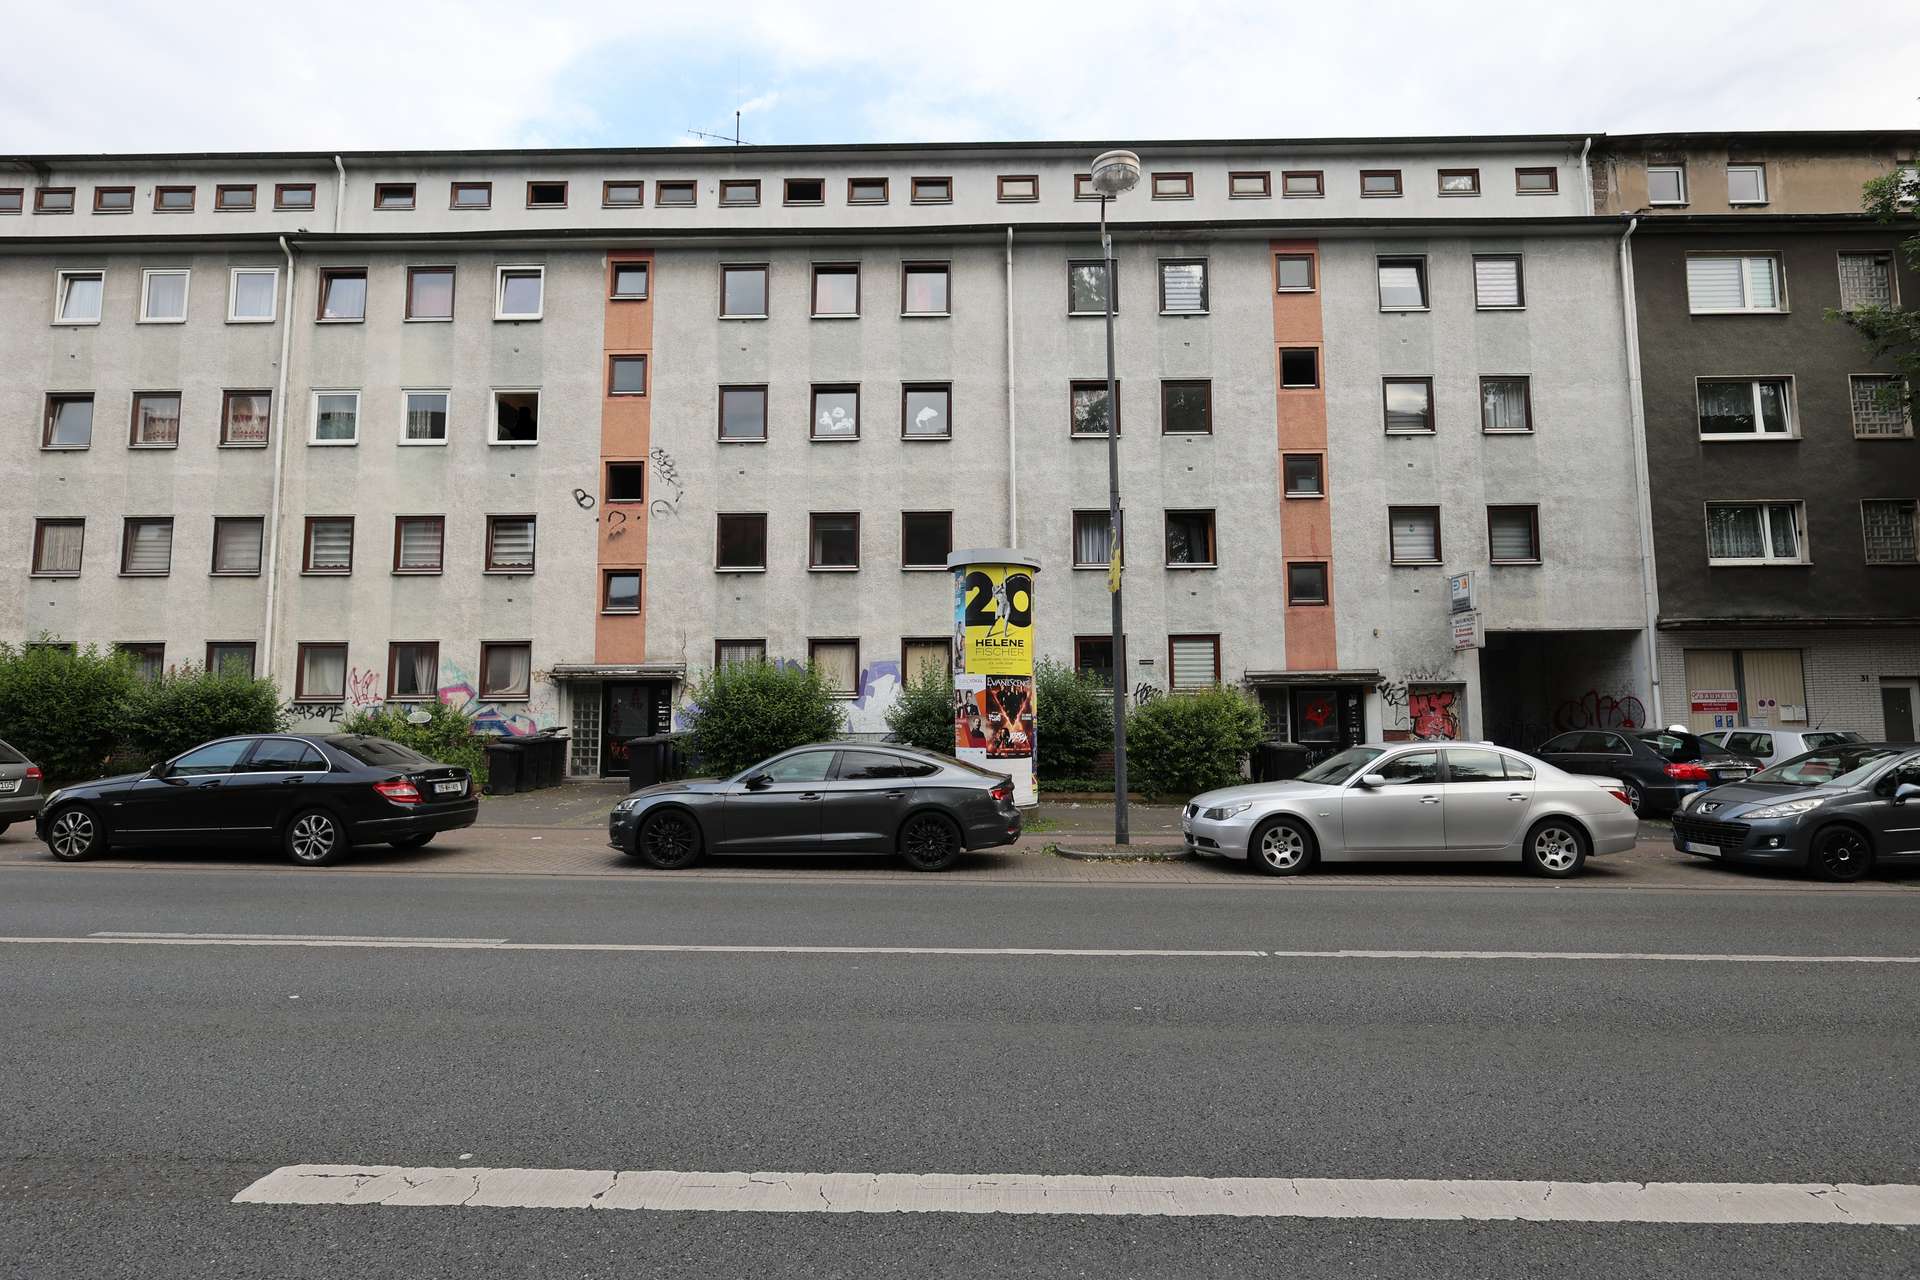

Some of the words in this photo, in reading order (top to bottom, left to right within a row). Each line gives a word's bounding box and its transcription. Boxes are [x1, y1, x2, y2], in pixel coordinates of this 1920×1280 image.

[965, 571, 1032, 627] 20
[975, 639, 1024, 648] HELENE
[975, 648, 1025, 657] FISCHER
